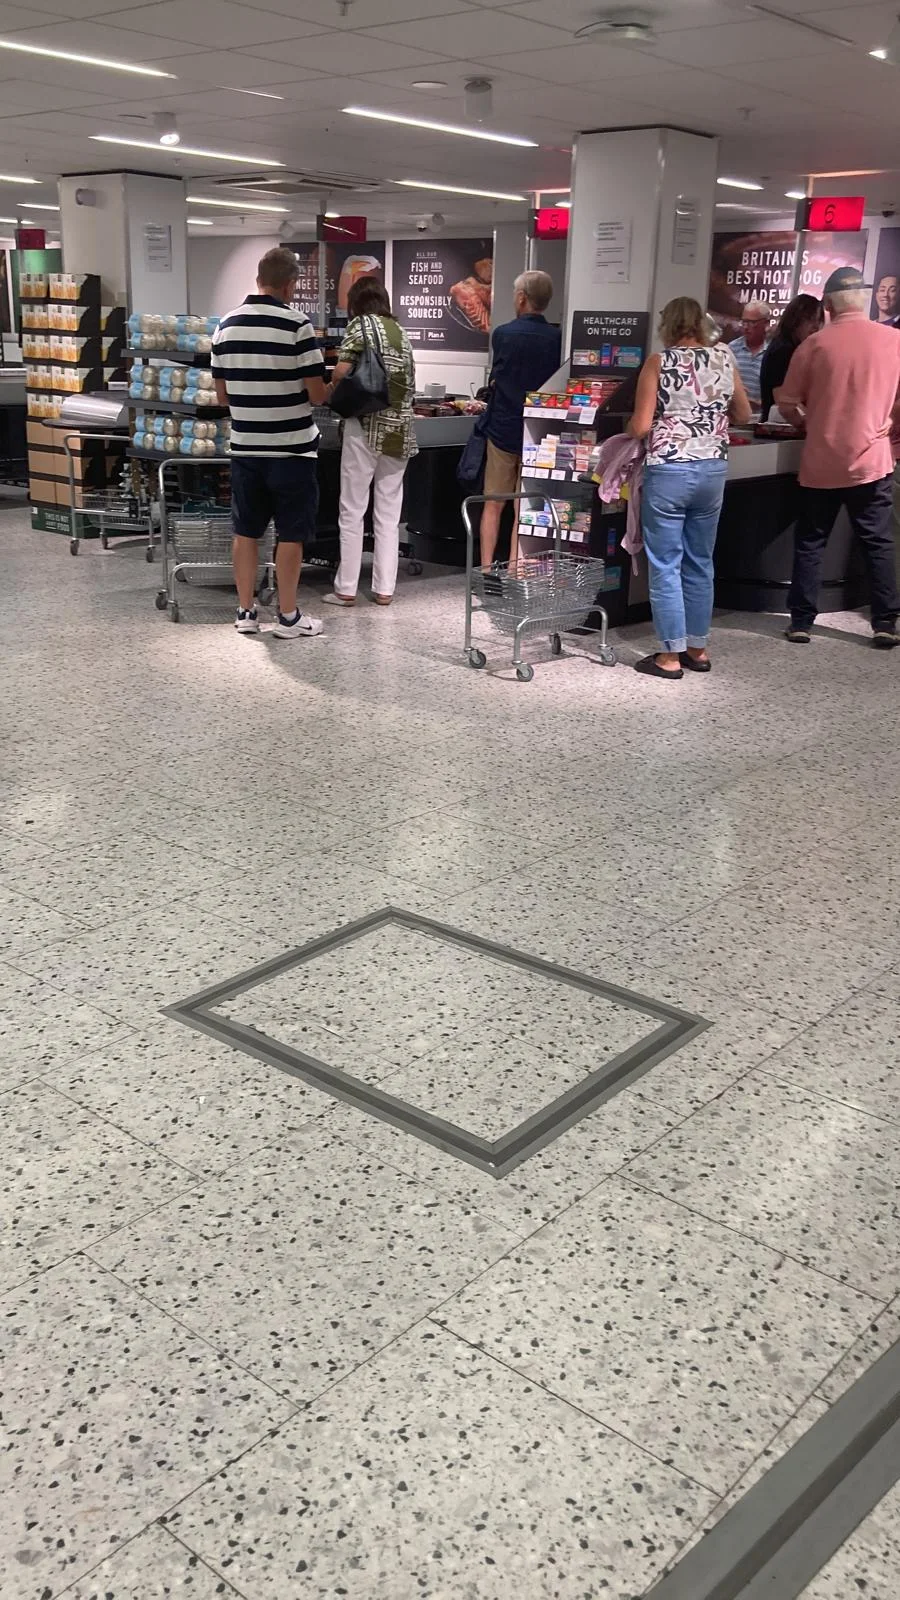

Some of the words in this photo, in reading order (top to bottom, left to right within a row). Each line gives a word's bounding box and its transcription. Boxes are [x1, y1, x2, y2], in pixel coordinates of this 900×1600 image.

[824, 204, 836, 224] 6
[549, 213, 559, 230] 5
[742, 250, 809, 266] BRITAINS
[411, 262, 429, 272] FISH
[408, 274, 444, 285] SEAFOOD
[727, 270, 760, 285] BEST
[763, 270, 791, 285] HOT
[799, 270, 822, 285] OG
[313, 278, 335, 290] EGS
[400, 295, 452, 306] RESPONSIBLY
[739, 288, 777, 304] MADE
[289, 302, 331, 314] PRODUCS
[407, 308, 443, 319] SOURCED
[583, 316, 638, 326] HEALTHCARE
[587, 327, 600, 336] ON
[601, 327, 617, 336] THE
[619, 328, 632, 336] GO
